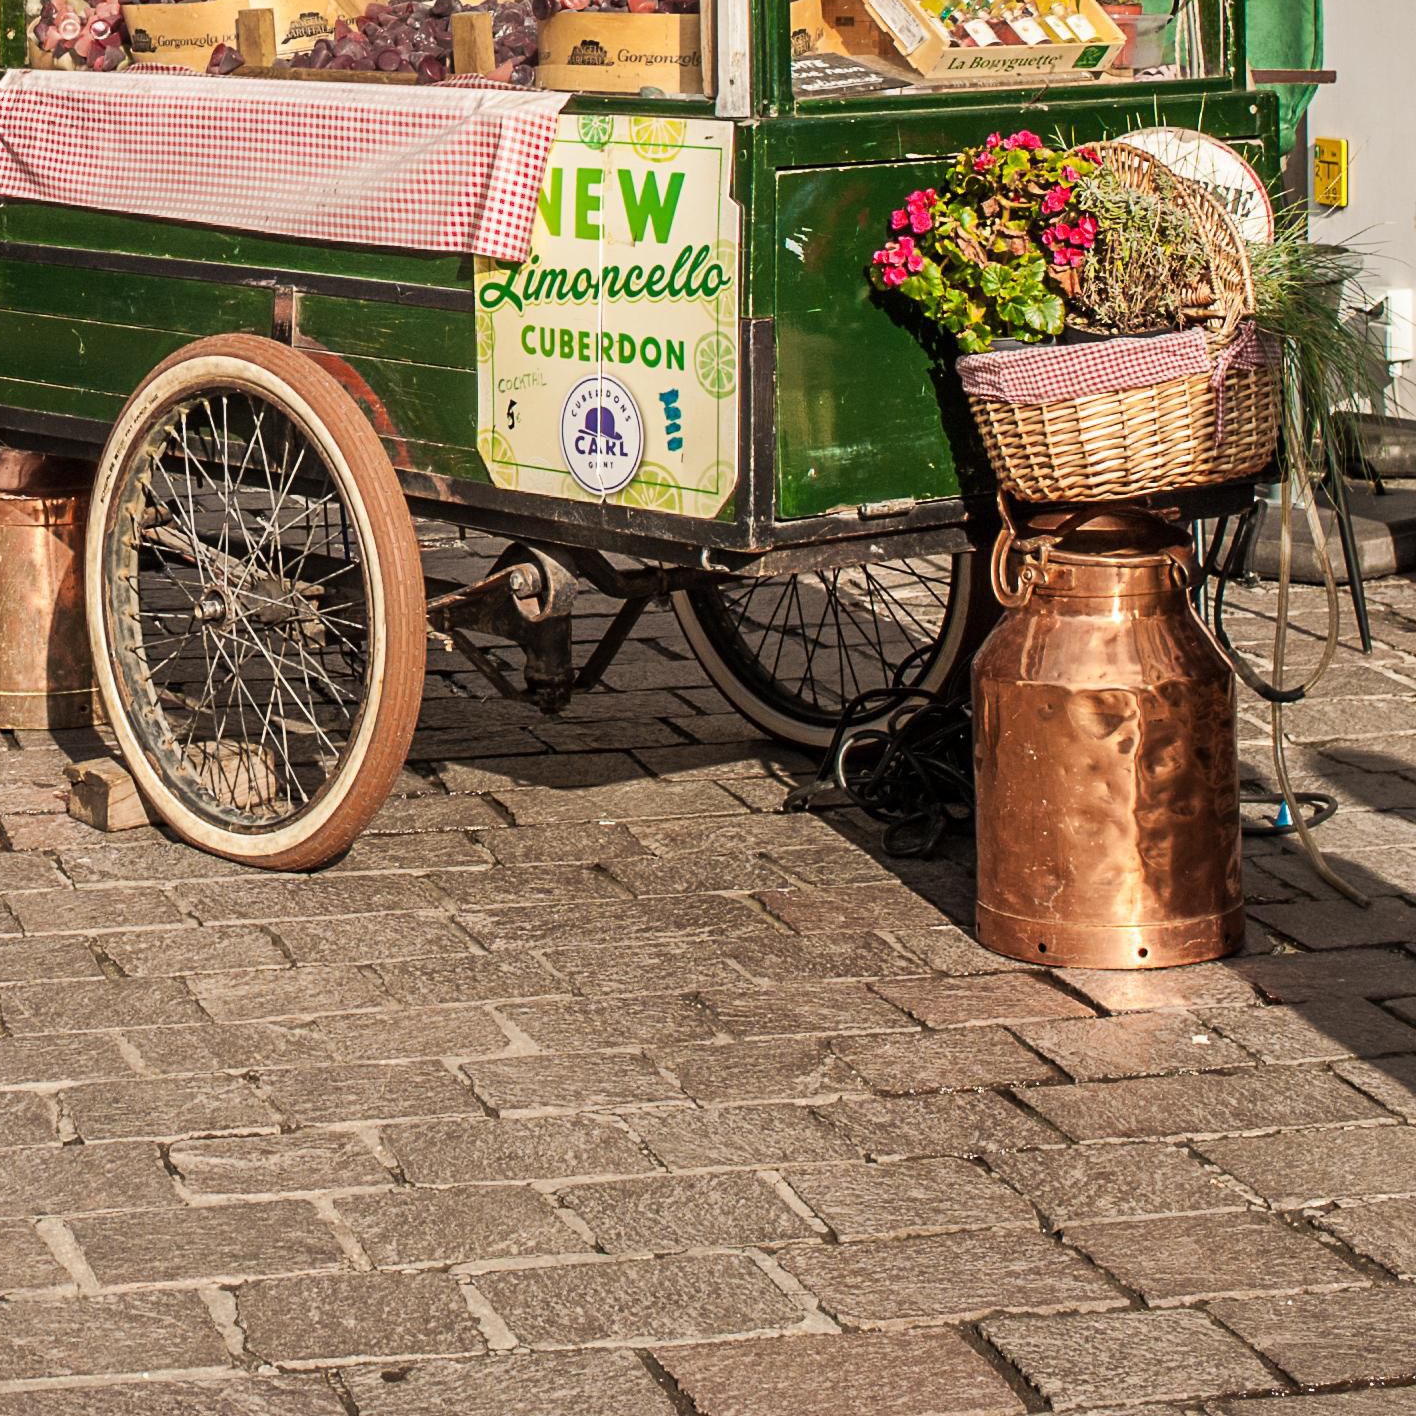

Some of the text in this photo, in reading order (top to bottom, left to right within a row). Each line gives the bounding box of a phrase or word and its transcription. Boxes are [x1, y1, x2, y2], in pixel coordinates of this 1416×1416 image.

[156, 34, 219, 48] Gorgonzola
[947, 56, 966, 70] La
[479, 244, 732, 312] Limoncello
[520, 324, 685, 371] CUBERDON
[574, 434, 629, 457] CARL
